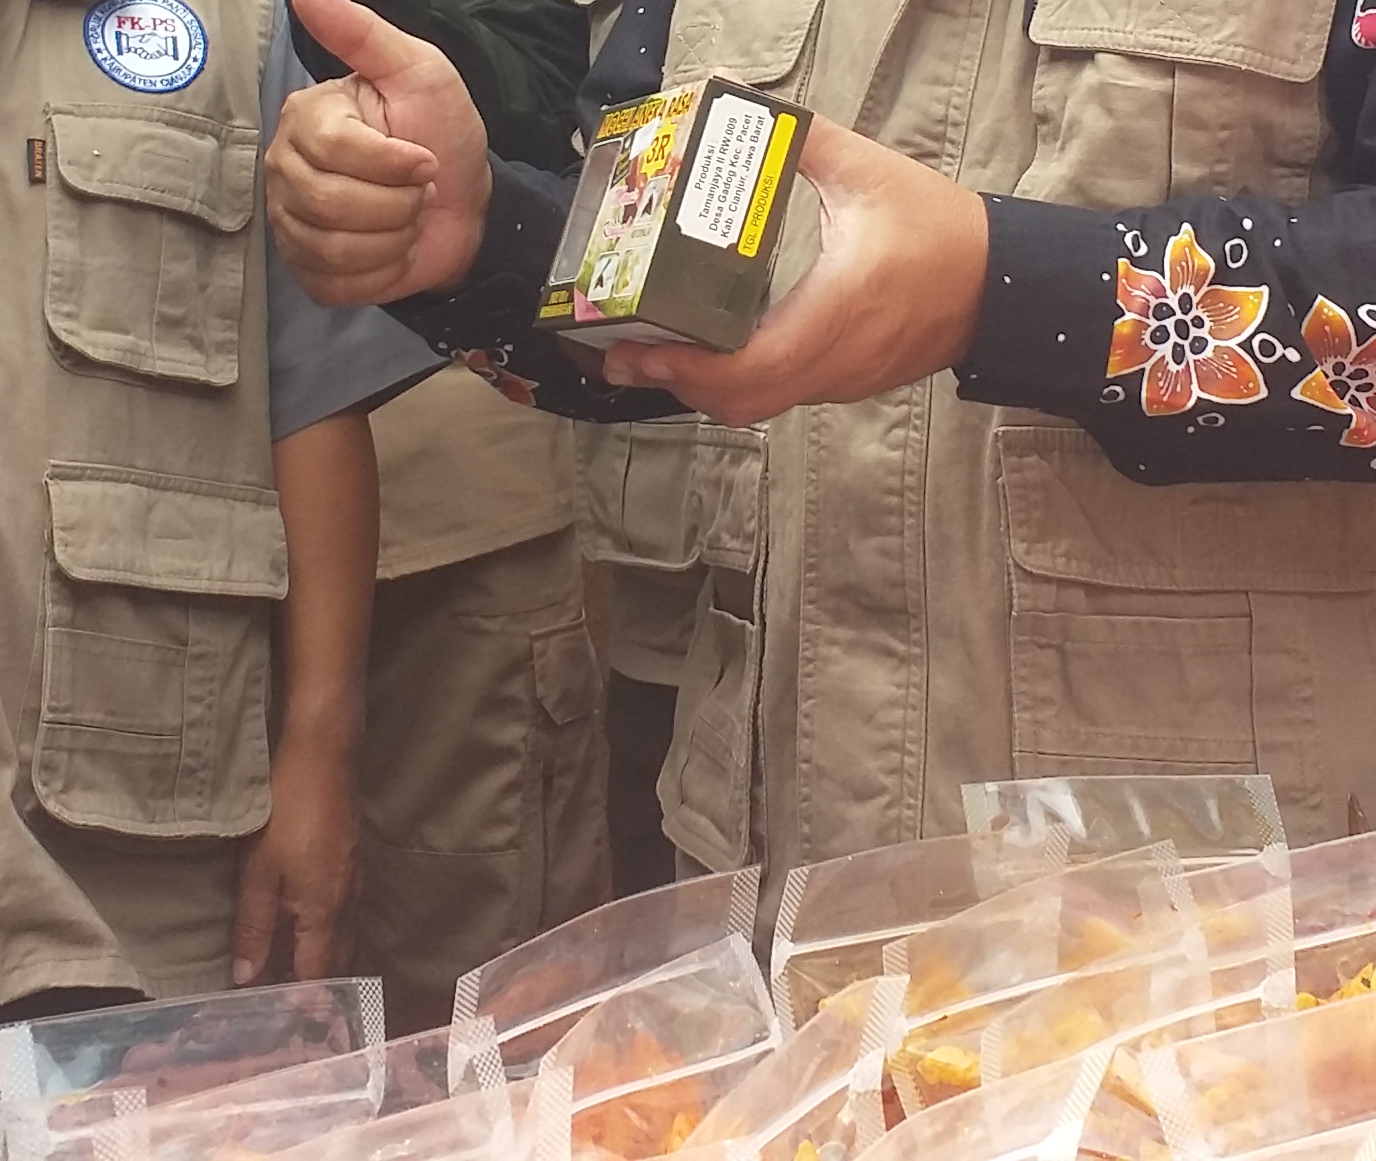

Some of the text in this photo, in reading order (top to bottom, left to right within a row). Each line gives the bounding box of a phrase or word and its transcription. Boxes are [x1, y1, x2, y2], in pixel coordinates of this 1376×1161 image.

[116, 15, 176, 33] FK-PS
[186, 19, 203, 51] SOSIAL
[101, 56, 195, 88] KABUPATEN CIANJUR
[646, 133, 671, 164] 3R
[741, 146, 756, 172] Jawa
[750, 115, 766, 144] Barat
[694, 144, 716, 191] Produksi
[699, 167, 723, 219] Tamanjaya
[719, 117, 738, 156] RW.009
[708, 209, 725, 232] Desa
[717, 169, 737, 203] Gadog
[736, 114, 753, 143] Pacet
[751, 174, 774, 227] PRODUKSI
